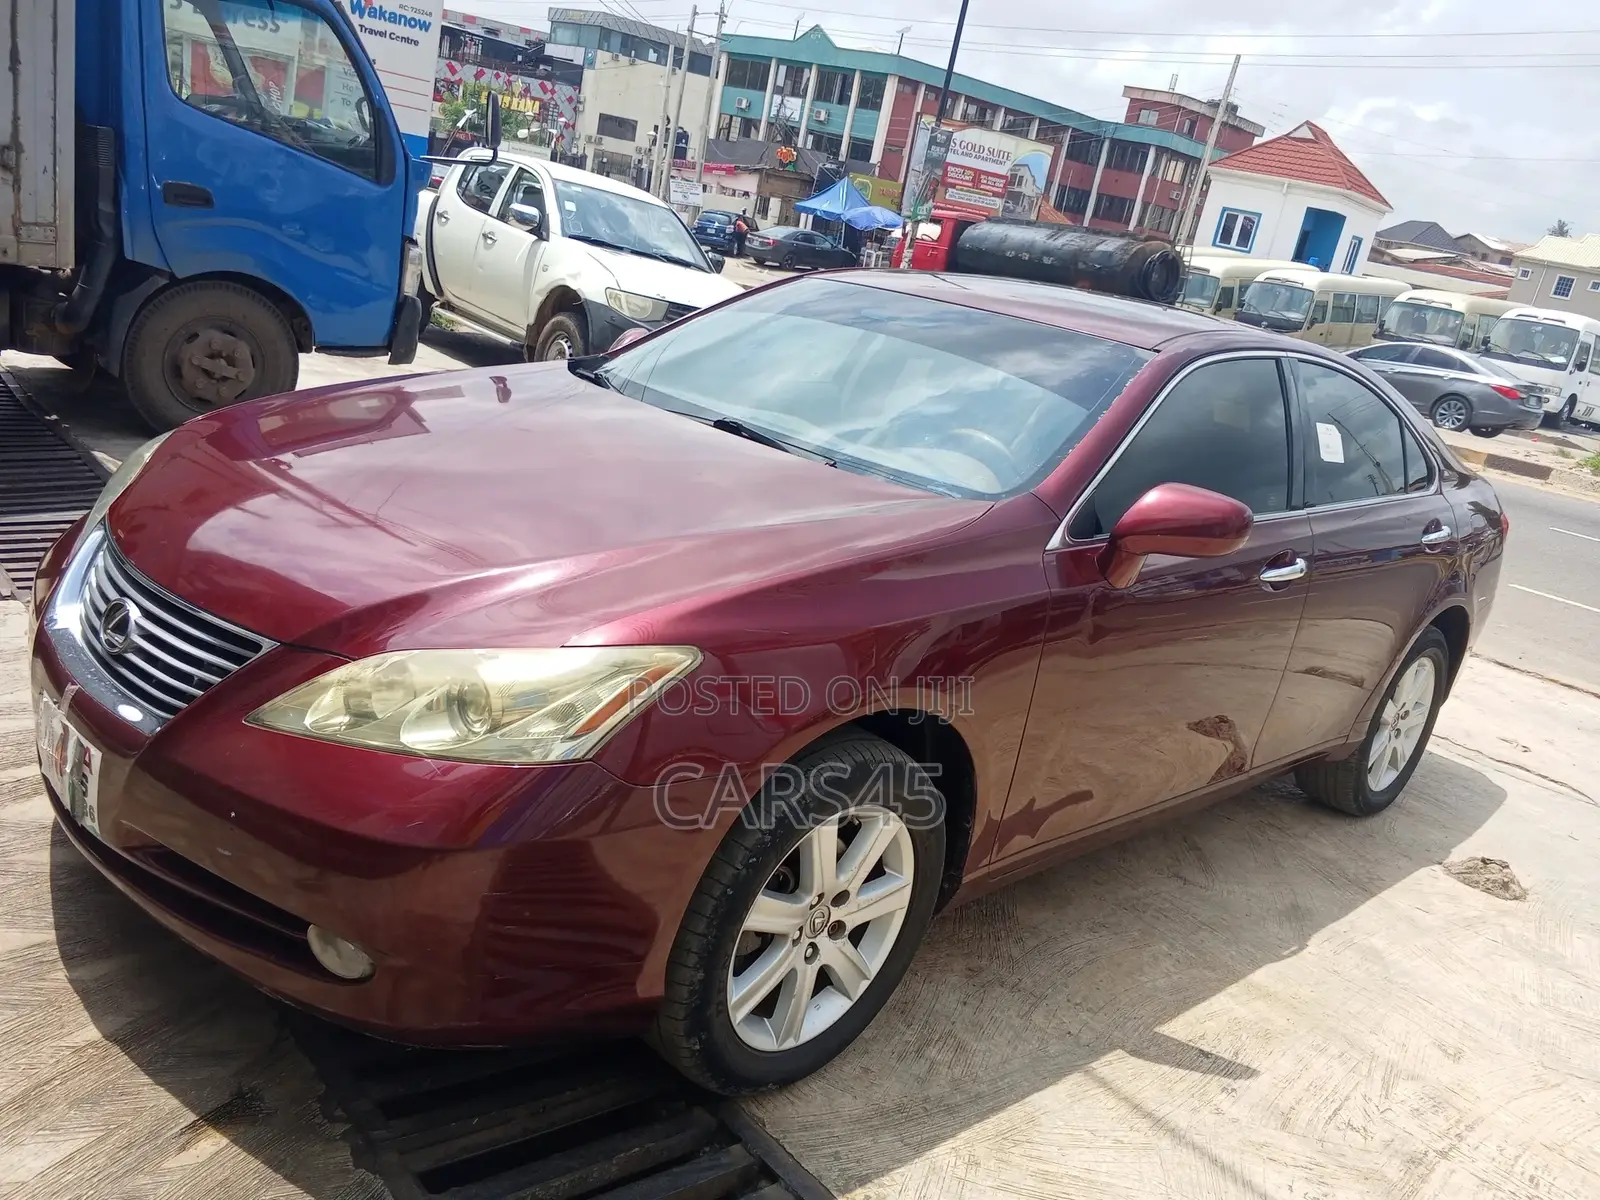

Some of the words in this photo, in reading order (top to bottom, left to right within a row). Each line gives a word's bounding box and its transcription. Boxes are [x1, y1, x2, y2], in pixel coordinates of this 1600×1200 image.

[349, 0, 432, 33] Wakanow
[358, 24, 387, 39] Travel
[389, 32, 420, 47] Centre
[959, 139, 985, 154] GOLD
[986, 146, 1013, 162] SUITE
[973, 154, 1007, 166] APARTMENT
